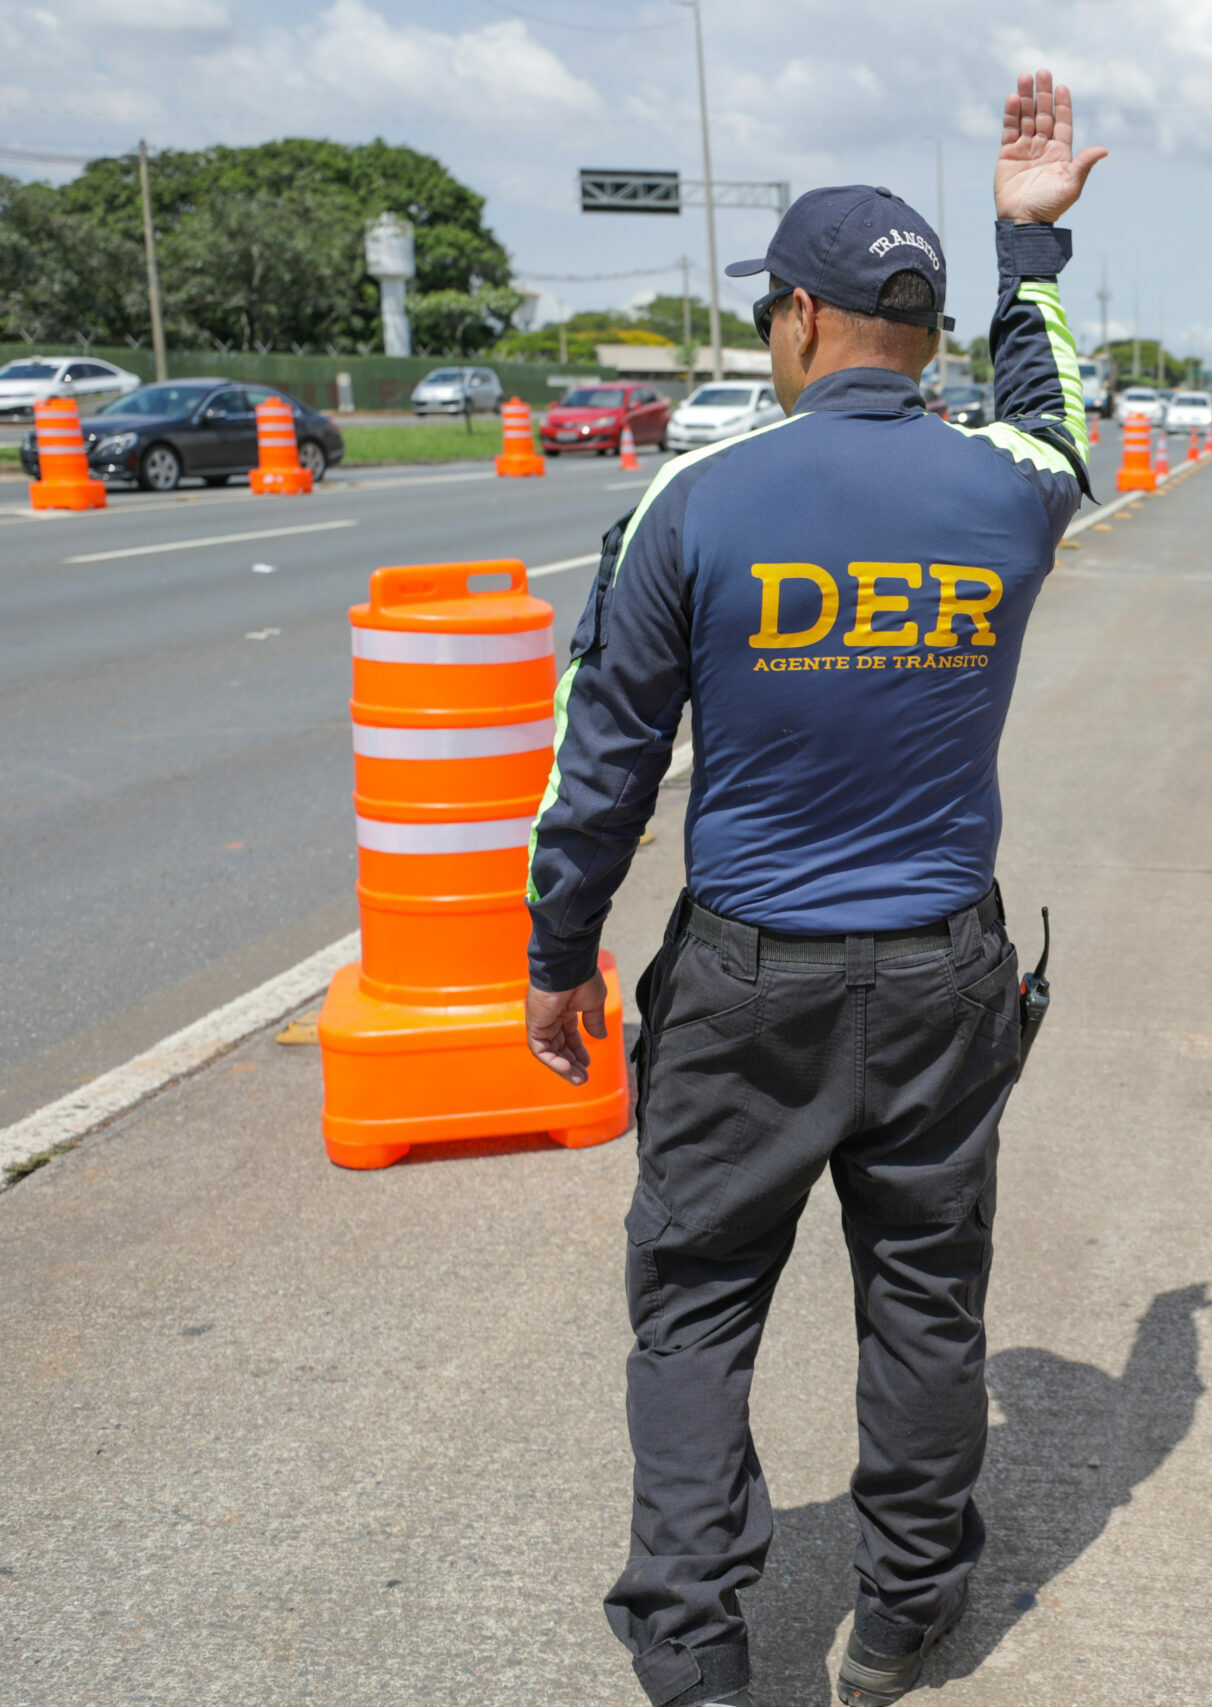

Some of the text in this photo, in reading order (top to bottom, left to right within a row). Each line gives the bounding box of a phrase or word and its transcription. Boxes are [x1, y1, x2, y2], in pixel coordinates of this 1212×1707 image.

[748, 561, 1004, 649] DER
[753, 653, 989, 672] AGENTE DE TRÂNSITO
